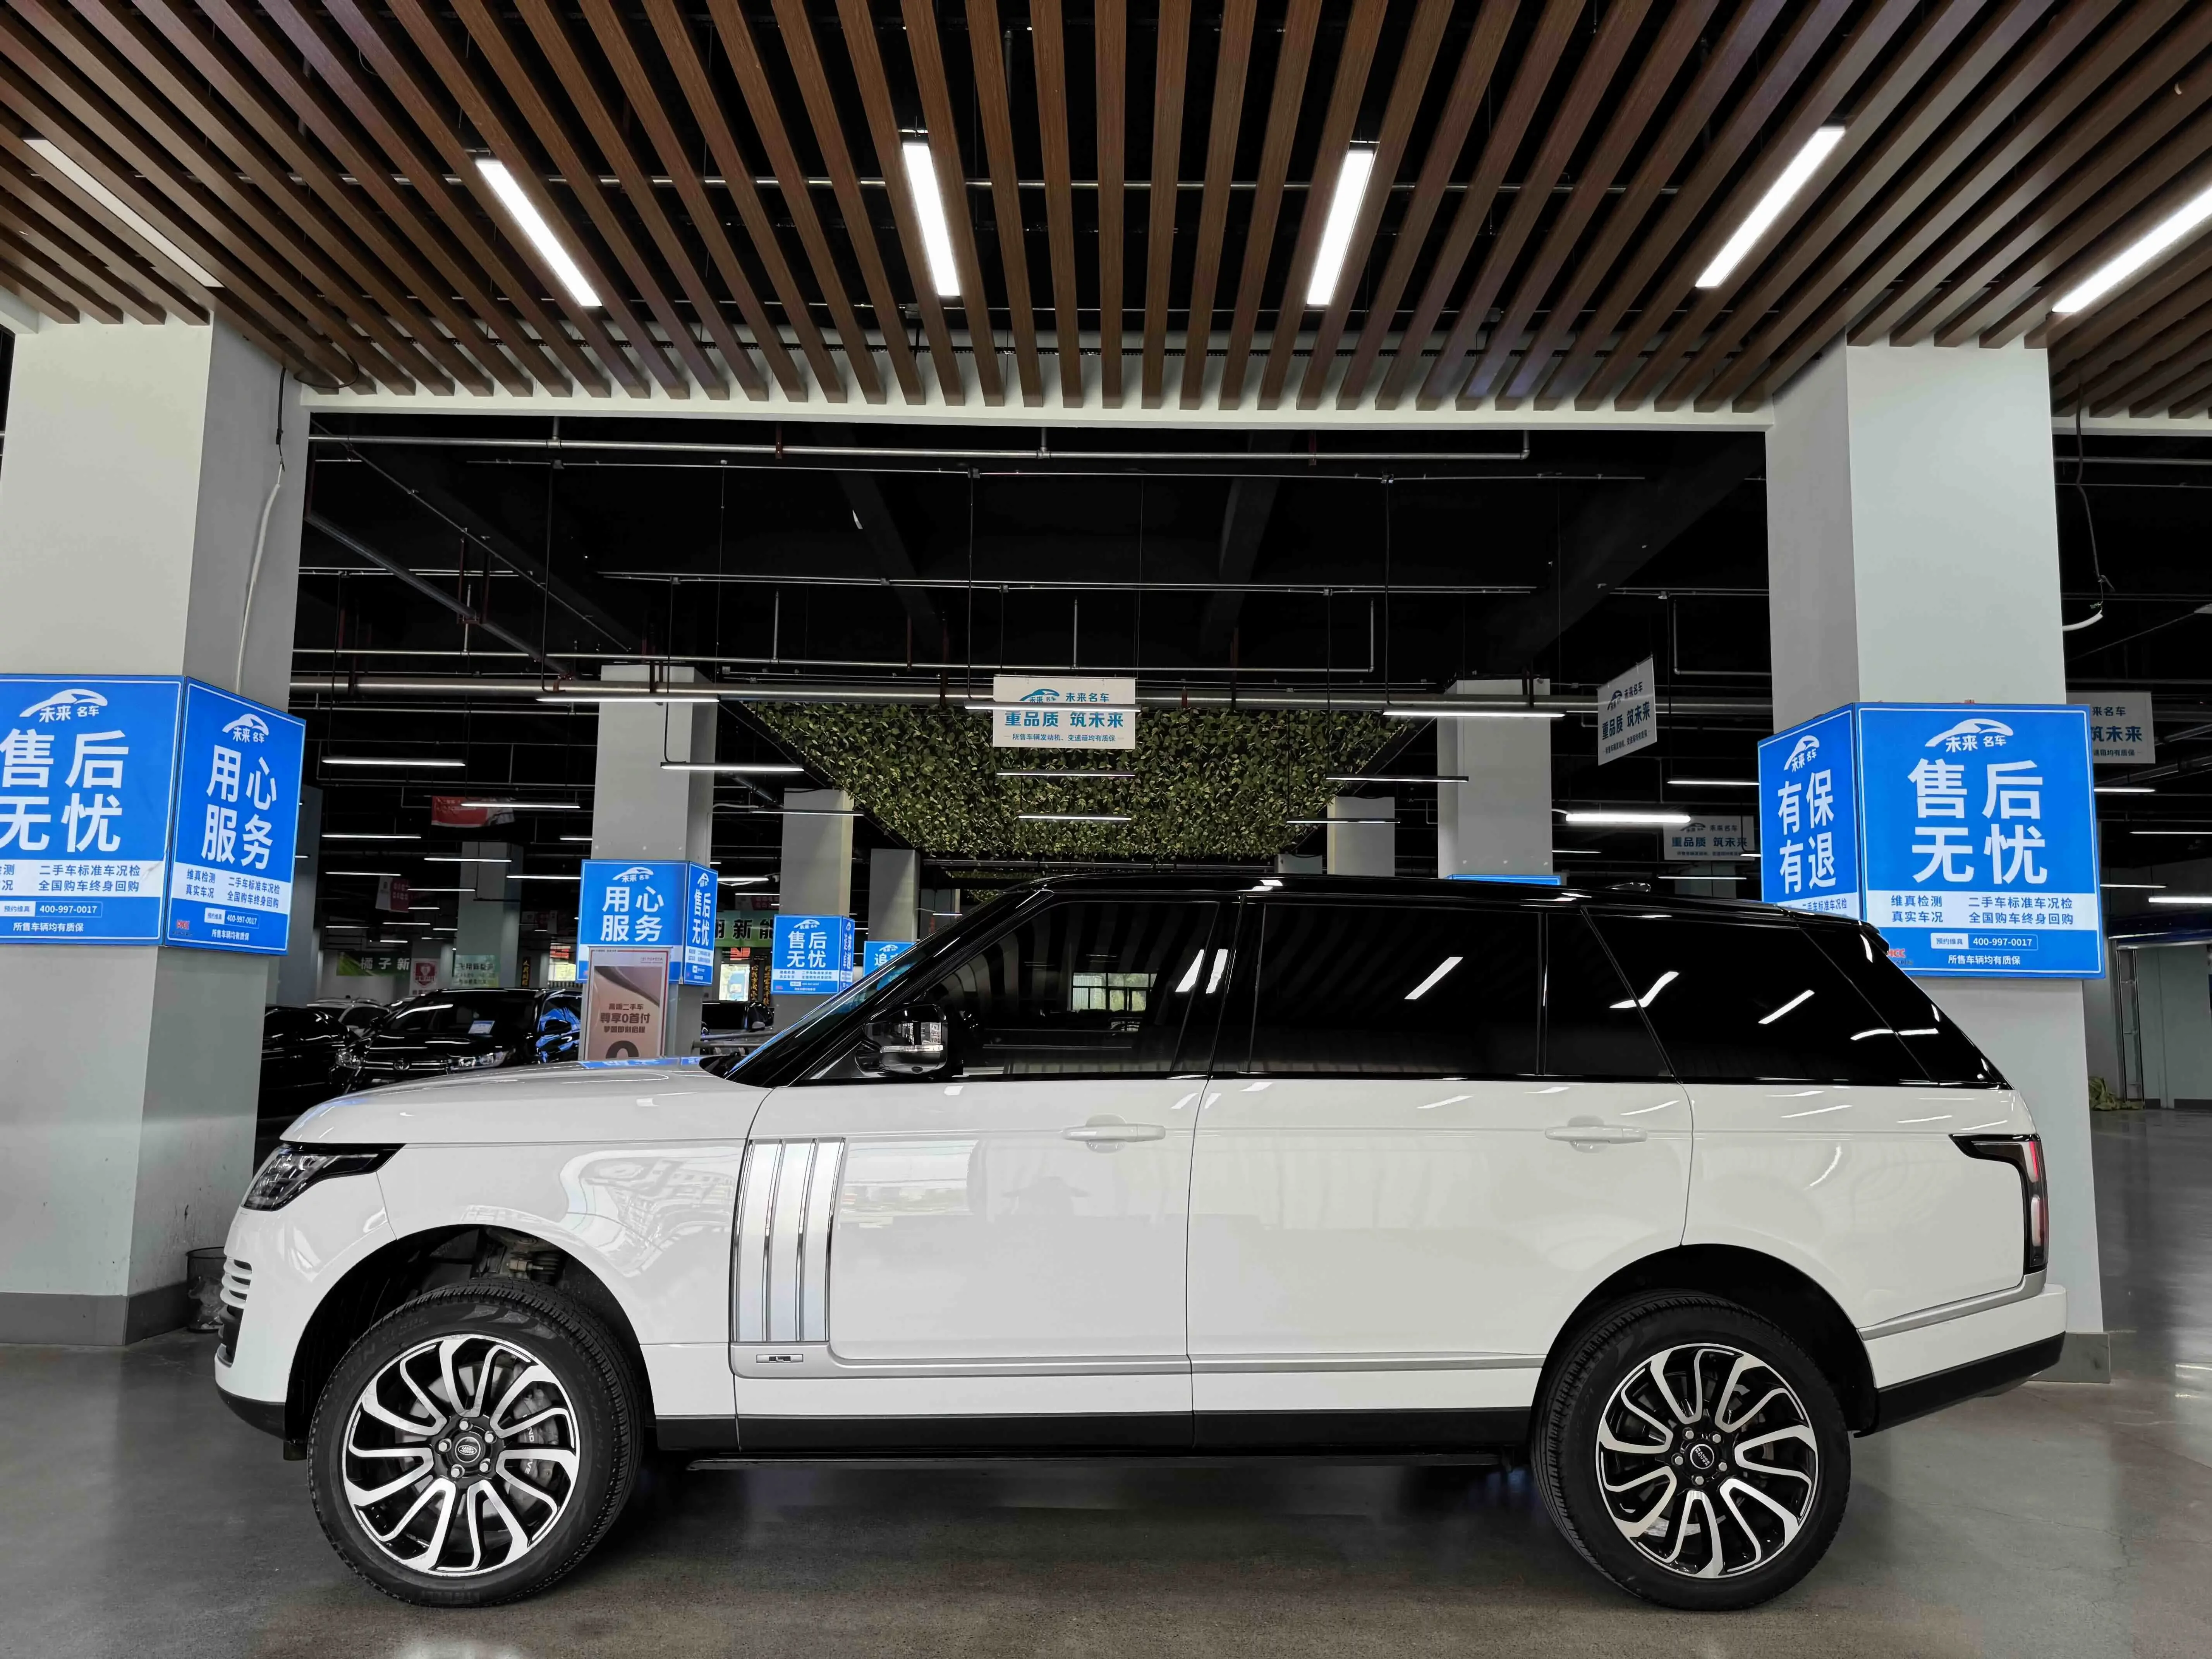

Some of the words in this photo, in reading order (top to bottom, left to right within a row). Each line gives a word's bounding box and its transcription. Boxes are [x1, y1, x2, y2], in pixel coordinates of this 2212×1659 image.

[1065, 692, 1109, 702] 未来名车
[40, 706, 71, 722] 未来
[77, 704, 99, 718] 名车
[1005, 711, 1059, 727] 重品质
[1070, 711, 1124, 728] 筑未来
[1602, 714, 1623, 740] 重品质
[1627, 701, 1650, 727] 筑未来
[232, 726, 250, 743] 未来
[253, 731, 265, 743] 名车
[1945, 735, 1978, 752] 未来
[1983, 734, 2007, 747] 名车
[0, 729, 129, 789] 售后
[1791, 755, 1805, 773] 未来
[1807, 750, 1817, 761] 名车
[206, 745, 276, 811] 用心
[1908, 758, 2043, 819] 售后
[1778, 769, 1834, 836] 有保
[0, 793, 123, 852] 无忧
[201, 804, 273, 870] 服务
[1779, 831, 1836, 894] 有退
[1911, 824, 2047, 884] 无忧
[40, 865, 141, 876] 二手车标准车况检
[38, 880, 139, 892] 全国购车终身回购
[185, 884, 214, 898] 真实车况
[228, 877, 280, 895] 二手车标准车况检
[602, 886, 664, 912] 用心
[694, 889, 711, 919] 售后
[1891, 895, 1942, 907] 维真检测
[1968, 896, 2073, 909] 二手车标准车况检
[40, 905, 97, 914] 400-997-0017
[1892, 911, 1943, 923] 真实车况
[1969, 912, 2073, 925] 全国购车终身回购
[227, 914, 257, 925] 400-997-0017
[600, 914, 663, 942] 服务
[692, 919, 710, 946] 无忧
[788, 931, 827, 949] 售后
[1973, 938, 2032, 946] 400-997-0017
[787, 950, 826, 968] 无忧
[1948, 954, 2021, 966] 所售车辆均有质保
